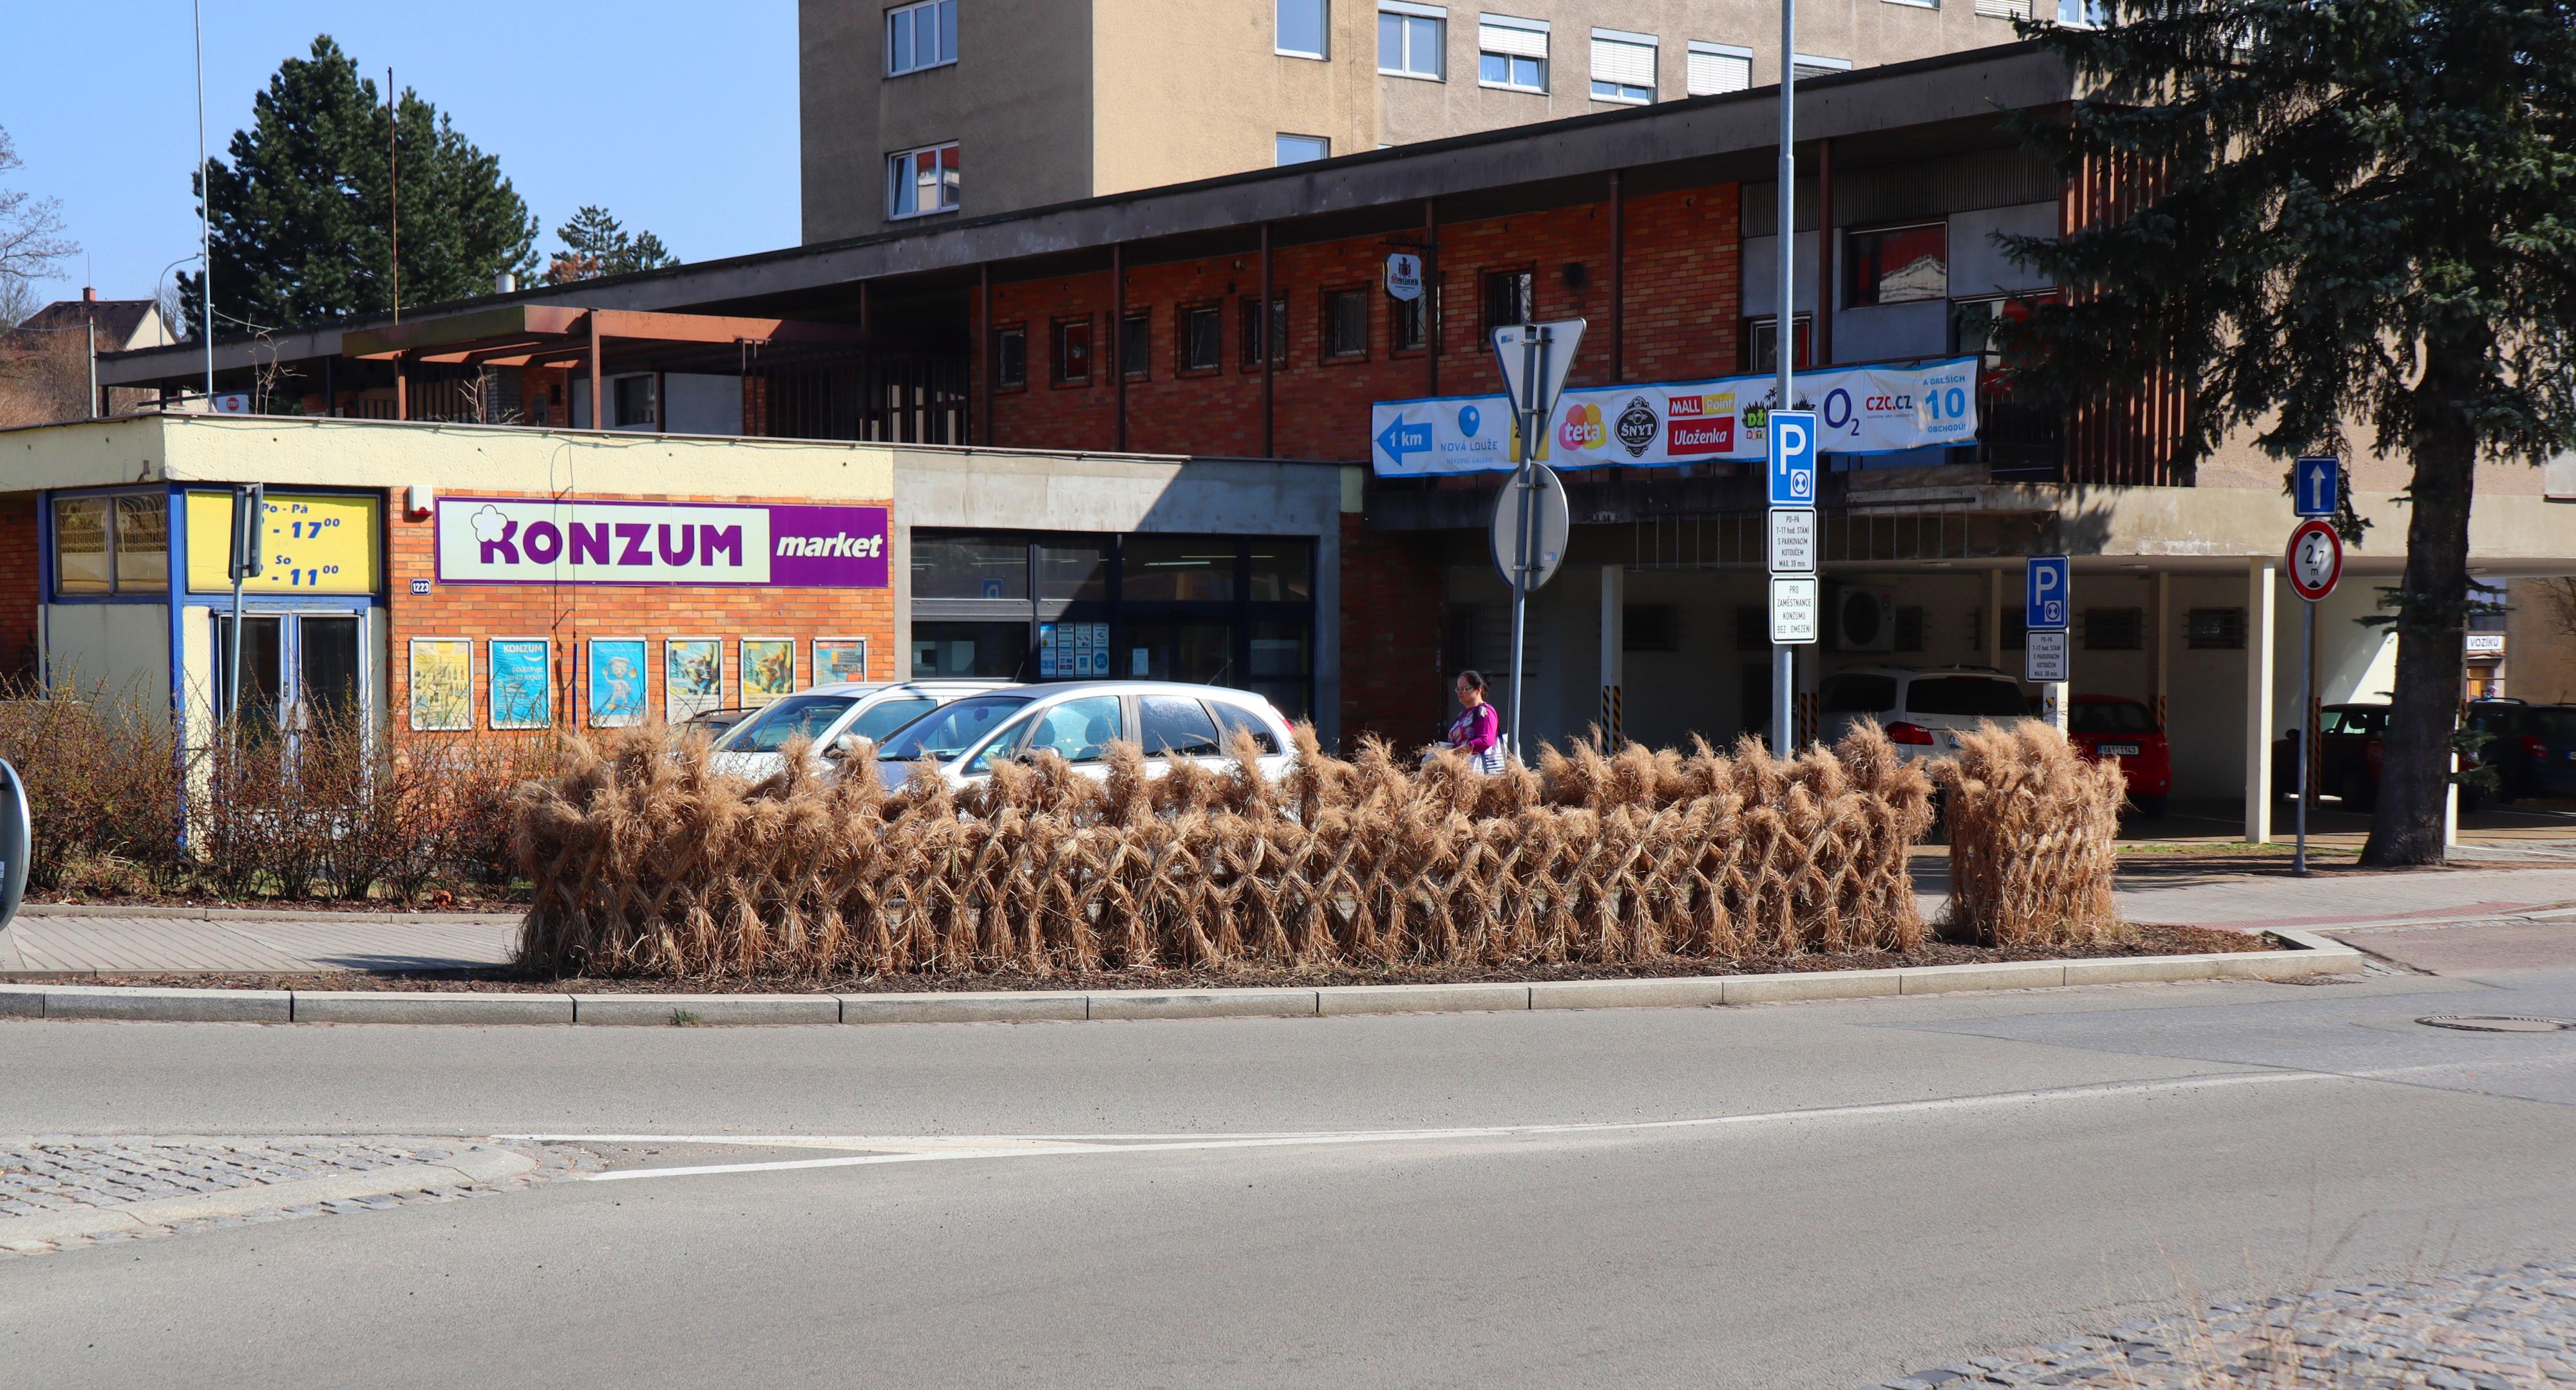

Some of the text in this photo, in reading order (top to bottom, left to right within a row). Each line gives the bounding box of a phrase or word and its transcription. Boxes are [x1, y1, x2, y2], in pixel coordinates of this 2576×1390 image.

[1930, 375, 1965, 385] DALŠÍCH
[1671, 396, 1732, 414] MALL Point
[1926, 388, 1965, 420] 10
[1565, 423, 1601, 442] teta
[1621, 422, 1654, 437] ŠNYT
[1927, 423, 1966, 433] OBCHODŮ!
[1390, 427, 1422, 447] 1 km
[1674, 426, 1727, 446] Uloženka
[1441, 439, 1497, 451] NOVÁ LOUŽE
[1780, 424, 1806, 474] P
[480, 520, 883, 567] KONZUM market
[1782, 547, 1804, 556] KOTOUČEM
[275, 555, 291, 565] So
[412, 583, 429, 592] 1223
[2036, 567, 2058, 606] P
[1777, 596, 1811, 606] ZAMĚSTNANCE
[1783, 612, 1806, 620] KONZUMU
[1791, 622, 1811, 633] OMEZENÍ
[504, 644, 543, 653] KONZUM
